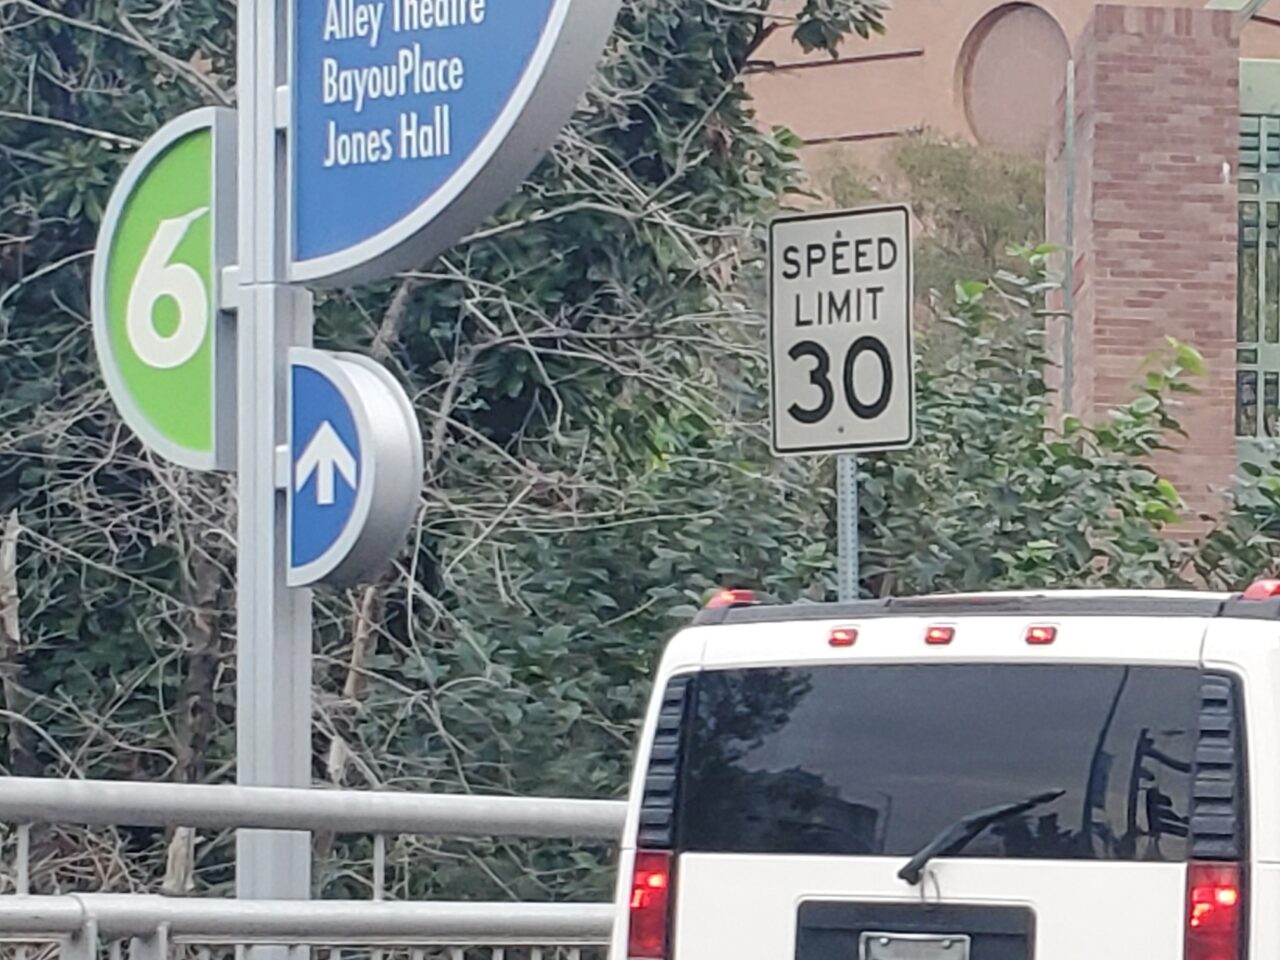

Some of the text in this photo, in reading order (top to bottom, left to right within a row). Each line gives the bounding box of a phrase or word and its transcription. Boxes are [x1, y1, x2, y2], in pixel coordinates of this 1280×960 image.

[323, 0, 384, 48] Alley
[323, 42, 464, 112] BayouPlace
[323, 104, 450, 167] Jones Hall
[126, 206, 210, 369] 6
[782, 237, 897, 280] SPEED
[794, 286, 884, 327] LIMIT
[787, 335, 893, 424] 30
